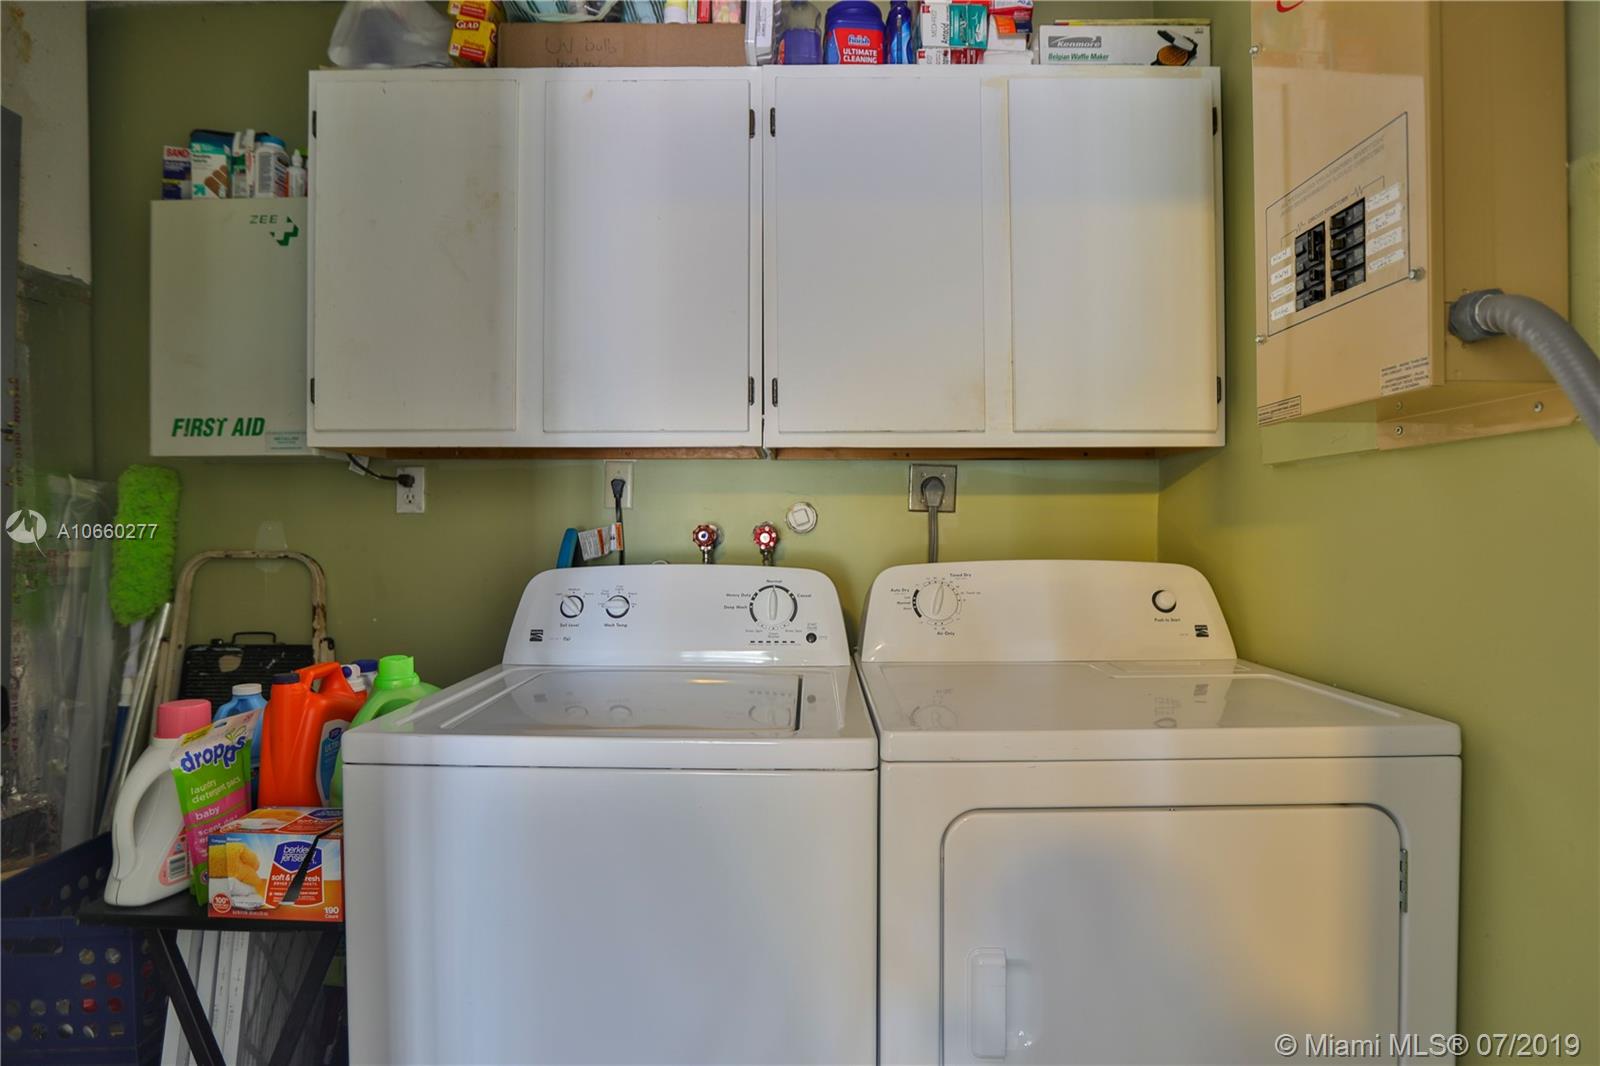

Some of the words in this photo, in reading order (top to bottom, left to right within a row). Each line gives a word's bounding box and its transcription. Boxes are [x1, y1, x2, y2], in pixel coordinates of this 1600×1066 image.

[455, 20, 479, 30] GLAD
[1057, 40, 1101, 48] Kenmore
[843, 47, 878, 57] ULTIMATE
[1048, 53, 1070, 61] Belgian
[1071, 53, 1089, 61] Waffle
[843, 54, 878, 64] CLEANING
[250, 214, 278, 224] ZEE
[171, 417, 228, 437] FIRST
[231, 417, 266, 437] AID
[180, 735, 247, 772] dropps
[190, 777, 217, 795] laundry
[191, 784, 227, 804] detergent
[195, 805, 221, 821] baby
[271, 873, 284, 881] soft
